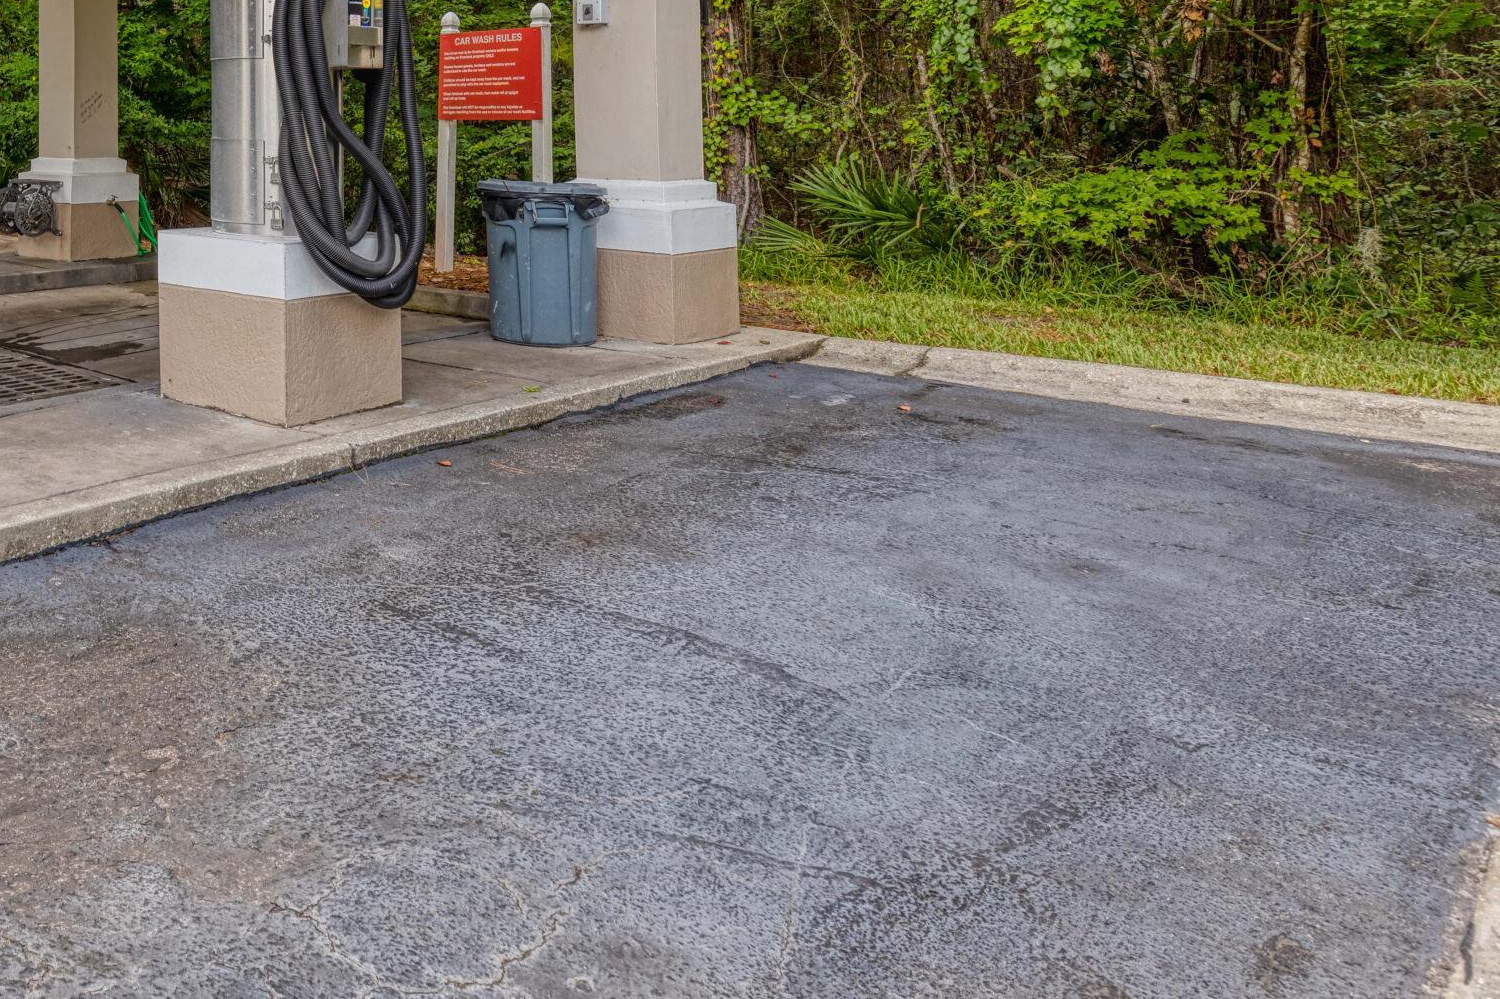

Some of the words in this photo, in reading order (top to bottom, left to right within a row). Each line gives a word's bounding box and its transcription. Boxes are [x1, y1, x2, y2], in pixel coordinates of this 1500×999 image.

[455, 36, 470, 46] CAR
[471, 35, 494, 44] WASH
[496, 32, 522, 42] RULES
